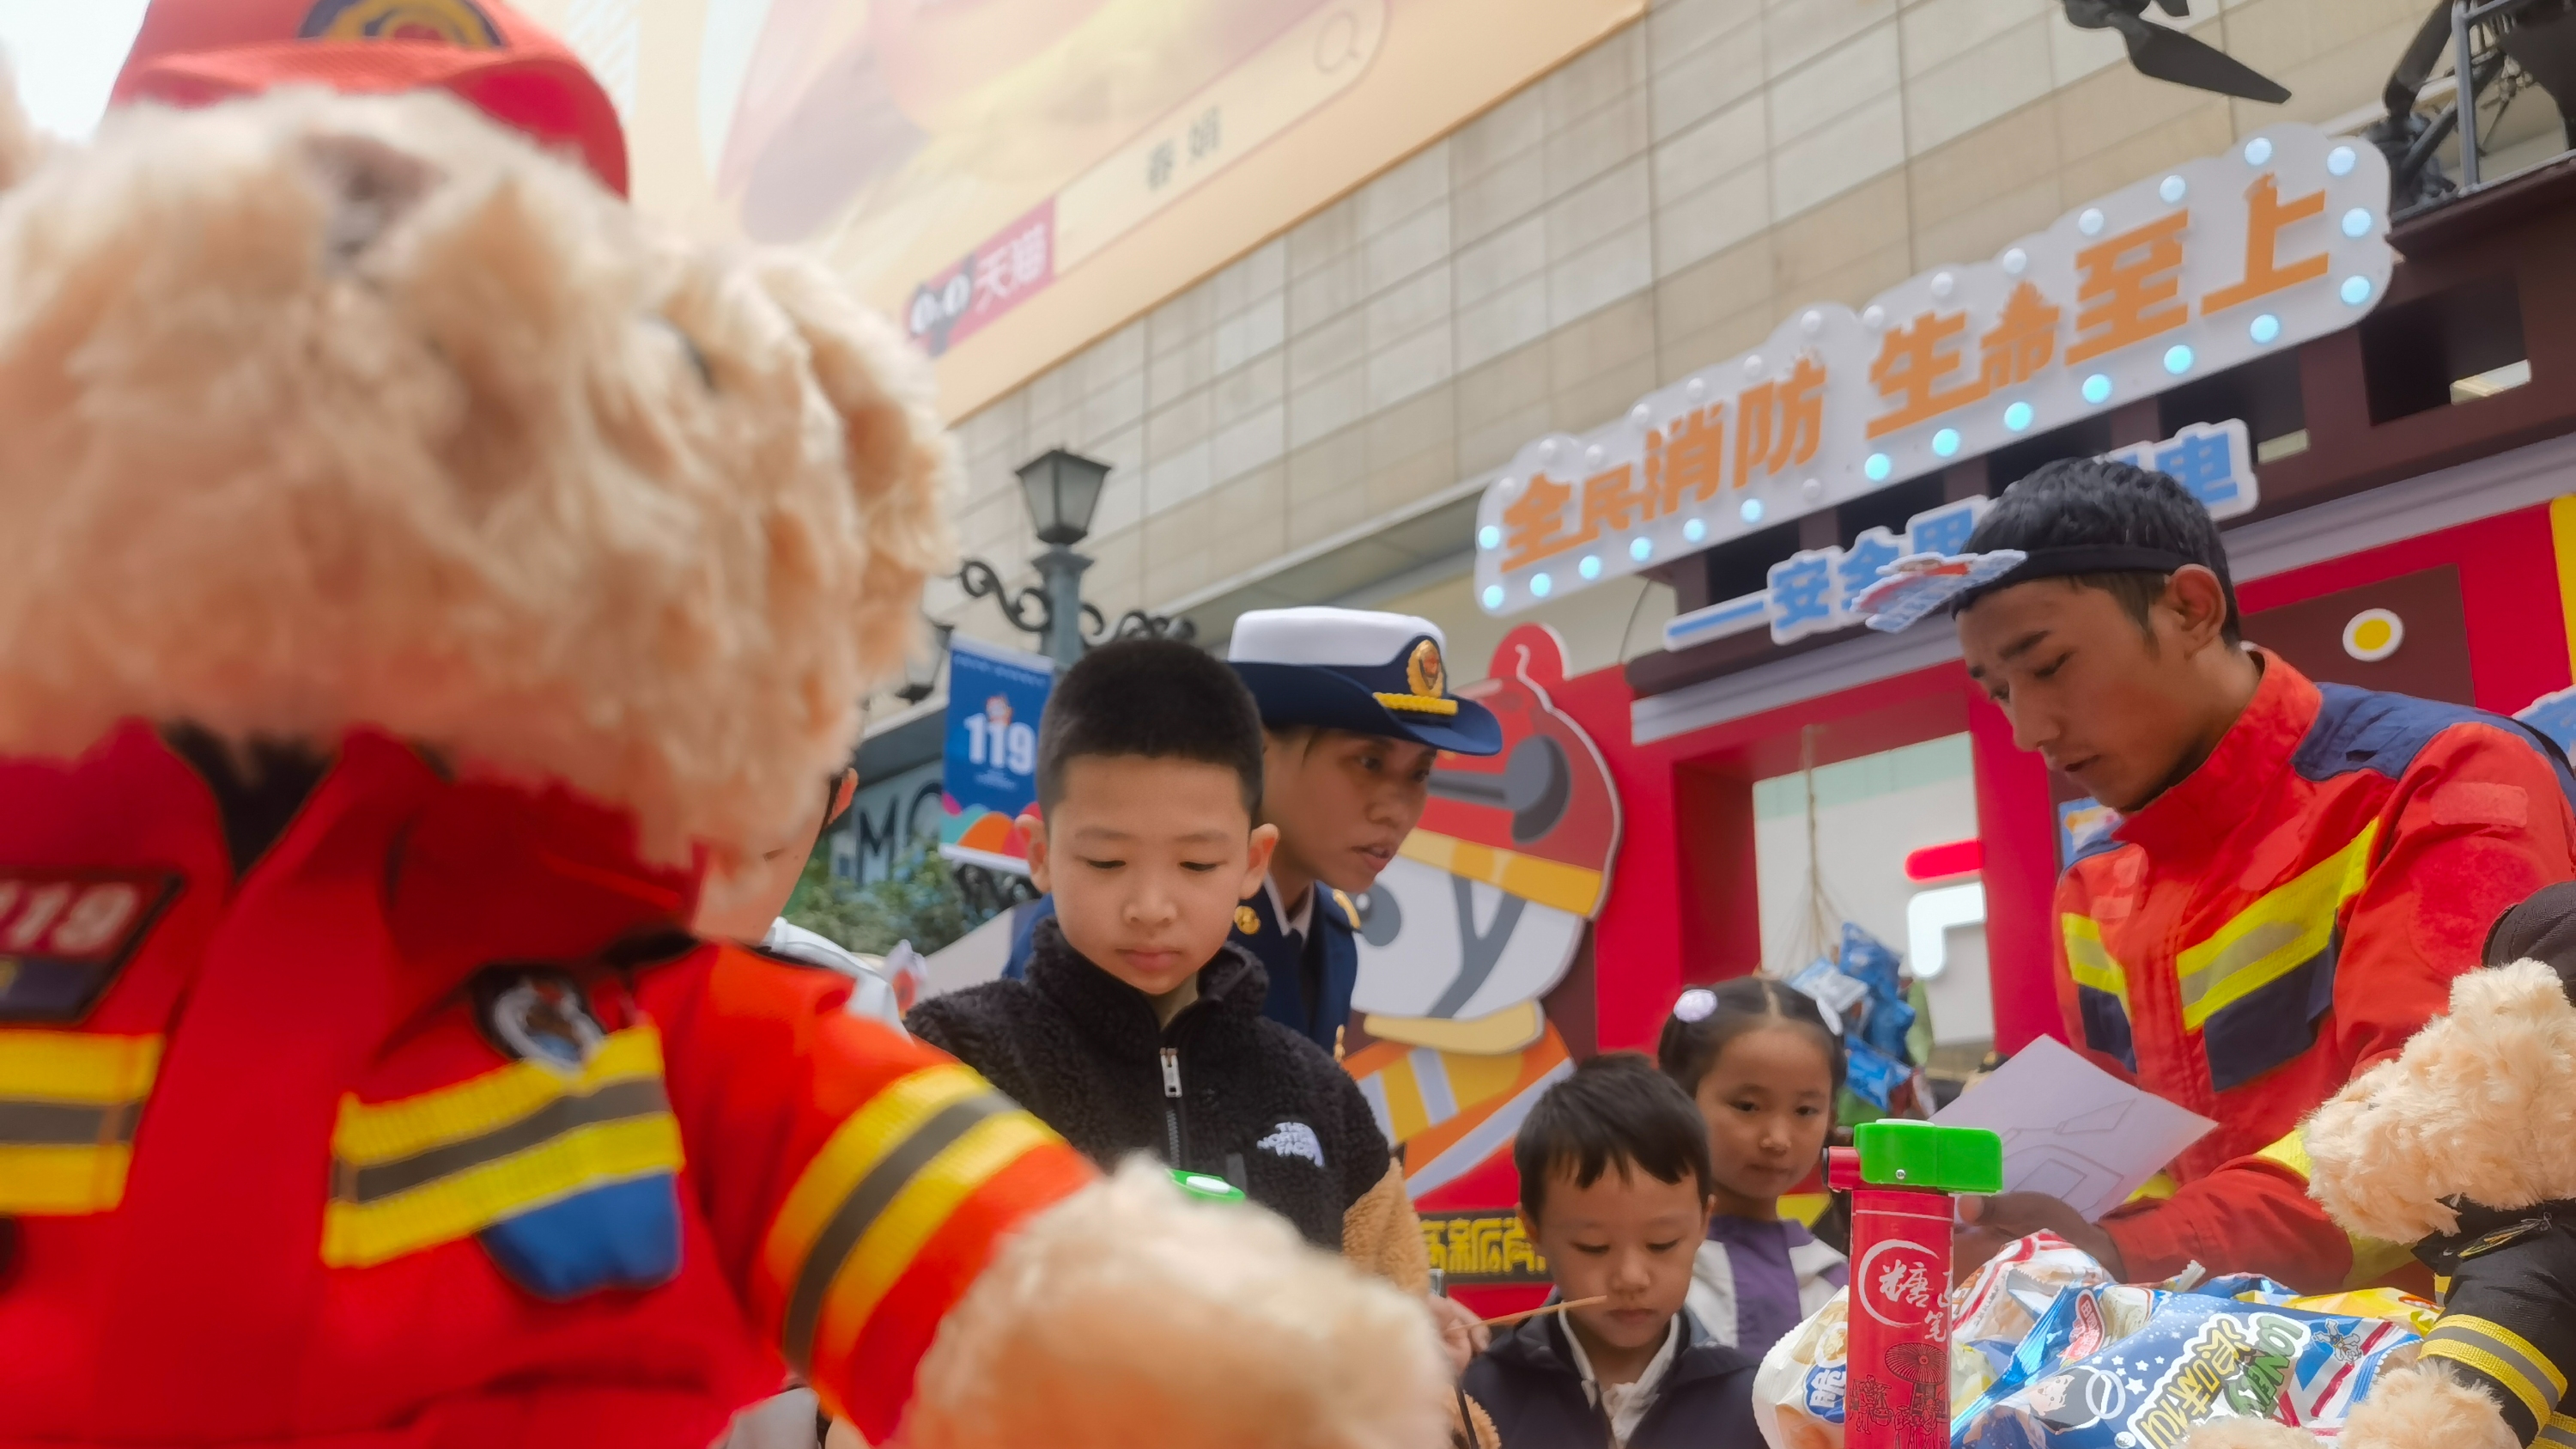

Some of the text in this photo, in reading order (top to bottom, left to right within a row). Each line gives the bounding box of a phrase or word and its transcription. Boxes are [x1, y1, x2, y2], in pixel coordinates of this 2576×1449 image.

[975, 223, 1047, 314] 天猫
[1500, 173, 2329, 573] 全民消防 生命至上
[963, 712, 1036, 776] 119
[0, 879, 137, 951] 19
[2138, 1318, 2252, 1449] 浪味仙
